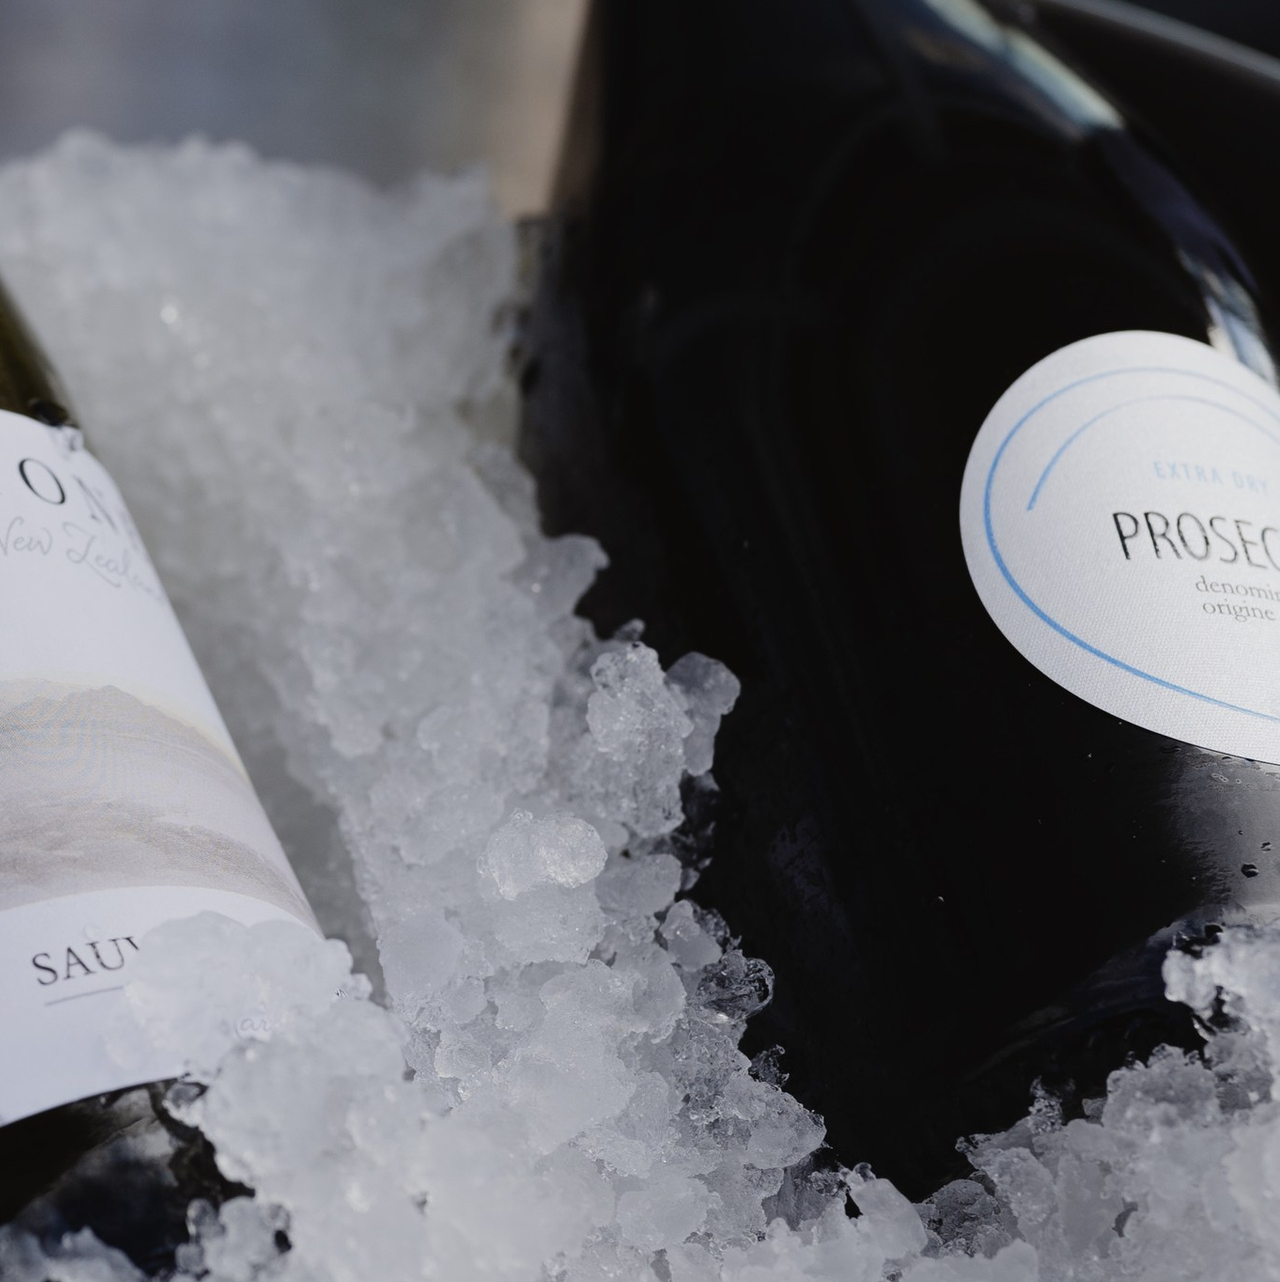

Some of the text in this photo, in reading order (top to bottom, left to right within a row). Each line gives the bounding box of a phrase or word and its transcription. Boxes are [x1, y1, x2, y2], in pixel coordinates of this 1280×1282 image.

[1152, 460, 1269, 496] EXTRA DRY
[1202, 598, 1277, 623] origine
